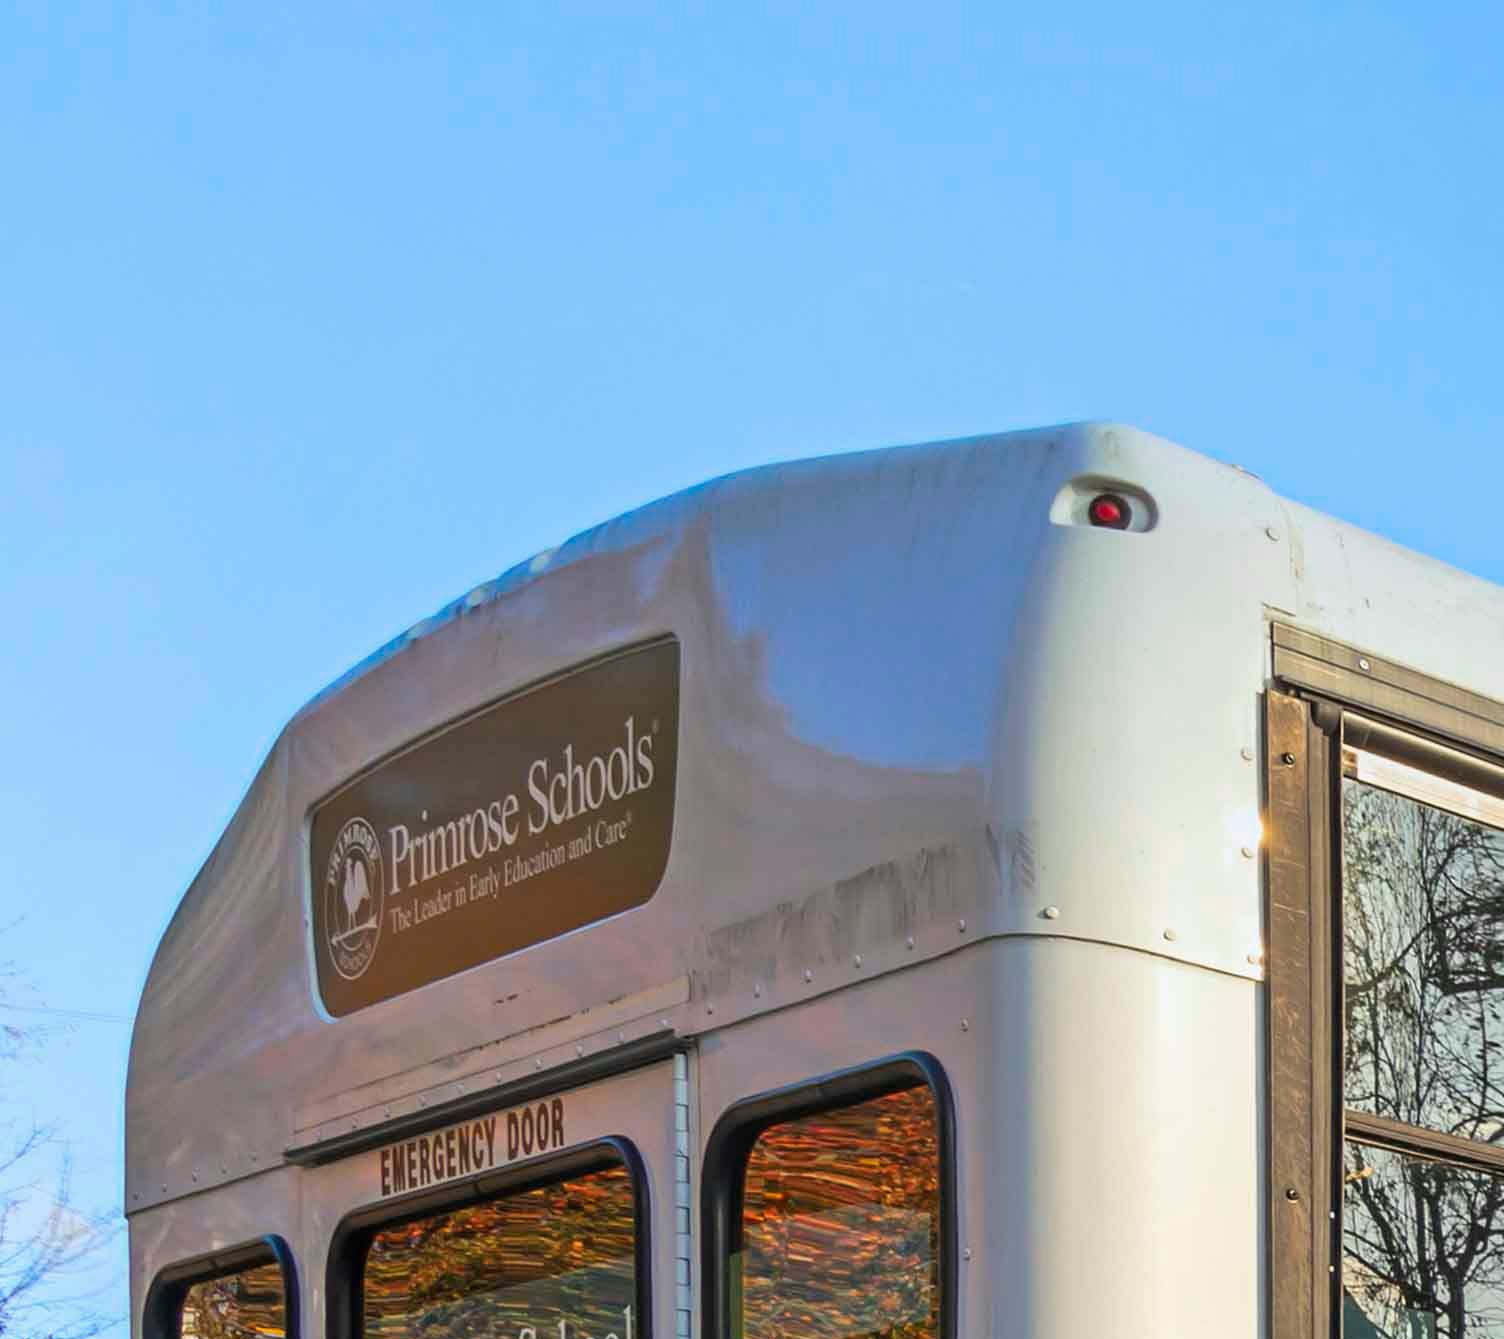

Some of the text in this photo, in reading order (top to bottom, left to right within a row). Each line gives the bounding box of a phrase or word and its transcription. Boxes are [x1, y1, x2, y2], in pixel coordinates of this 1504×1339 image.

[389, 794, 520, 896] Primrose
[389, 906, 411, 934] The
[414, 886, 453, 923] Leader
[455, 880, 467, 908] in
[470, 865, 500, 899] Early
[504, 841, 566, 887] Education
[568, 825, 593, 865] and
[381, 1097, 565, 1197] EMERGENCY DOOR
